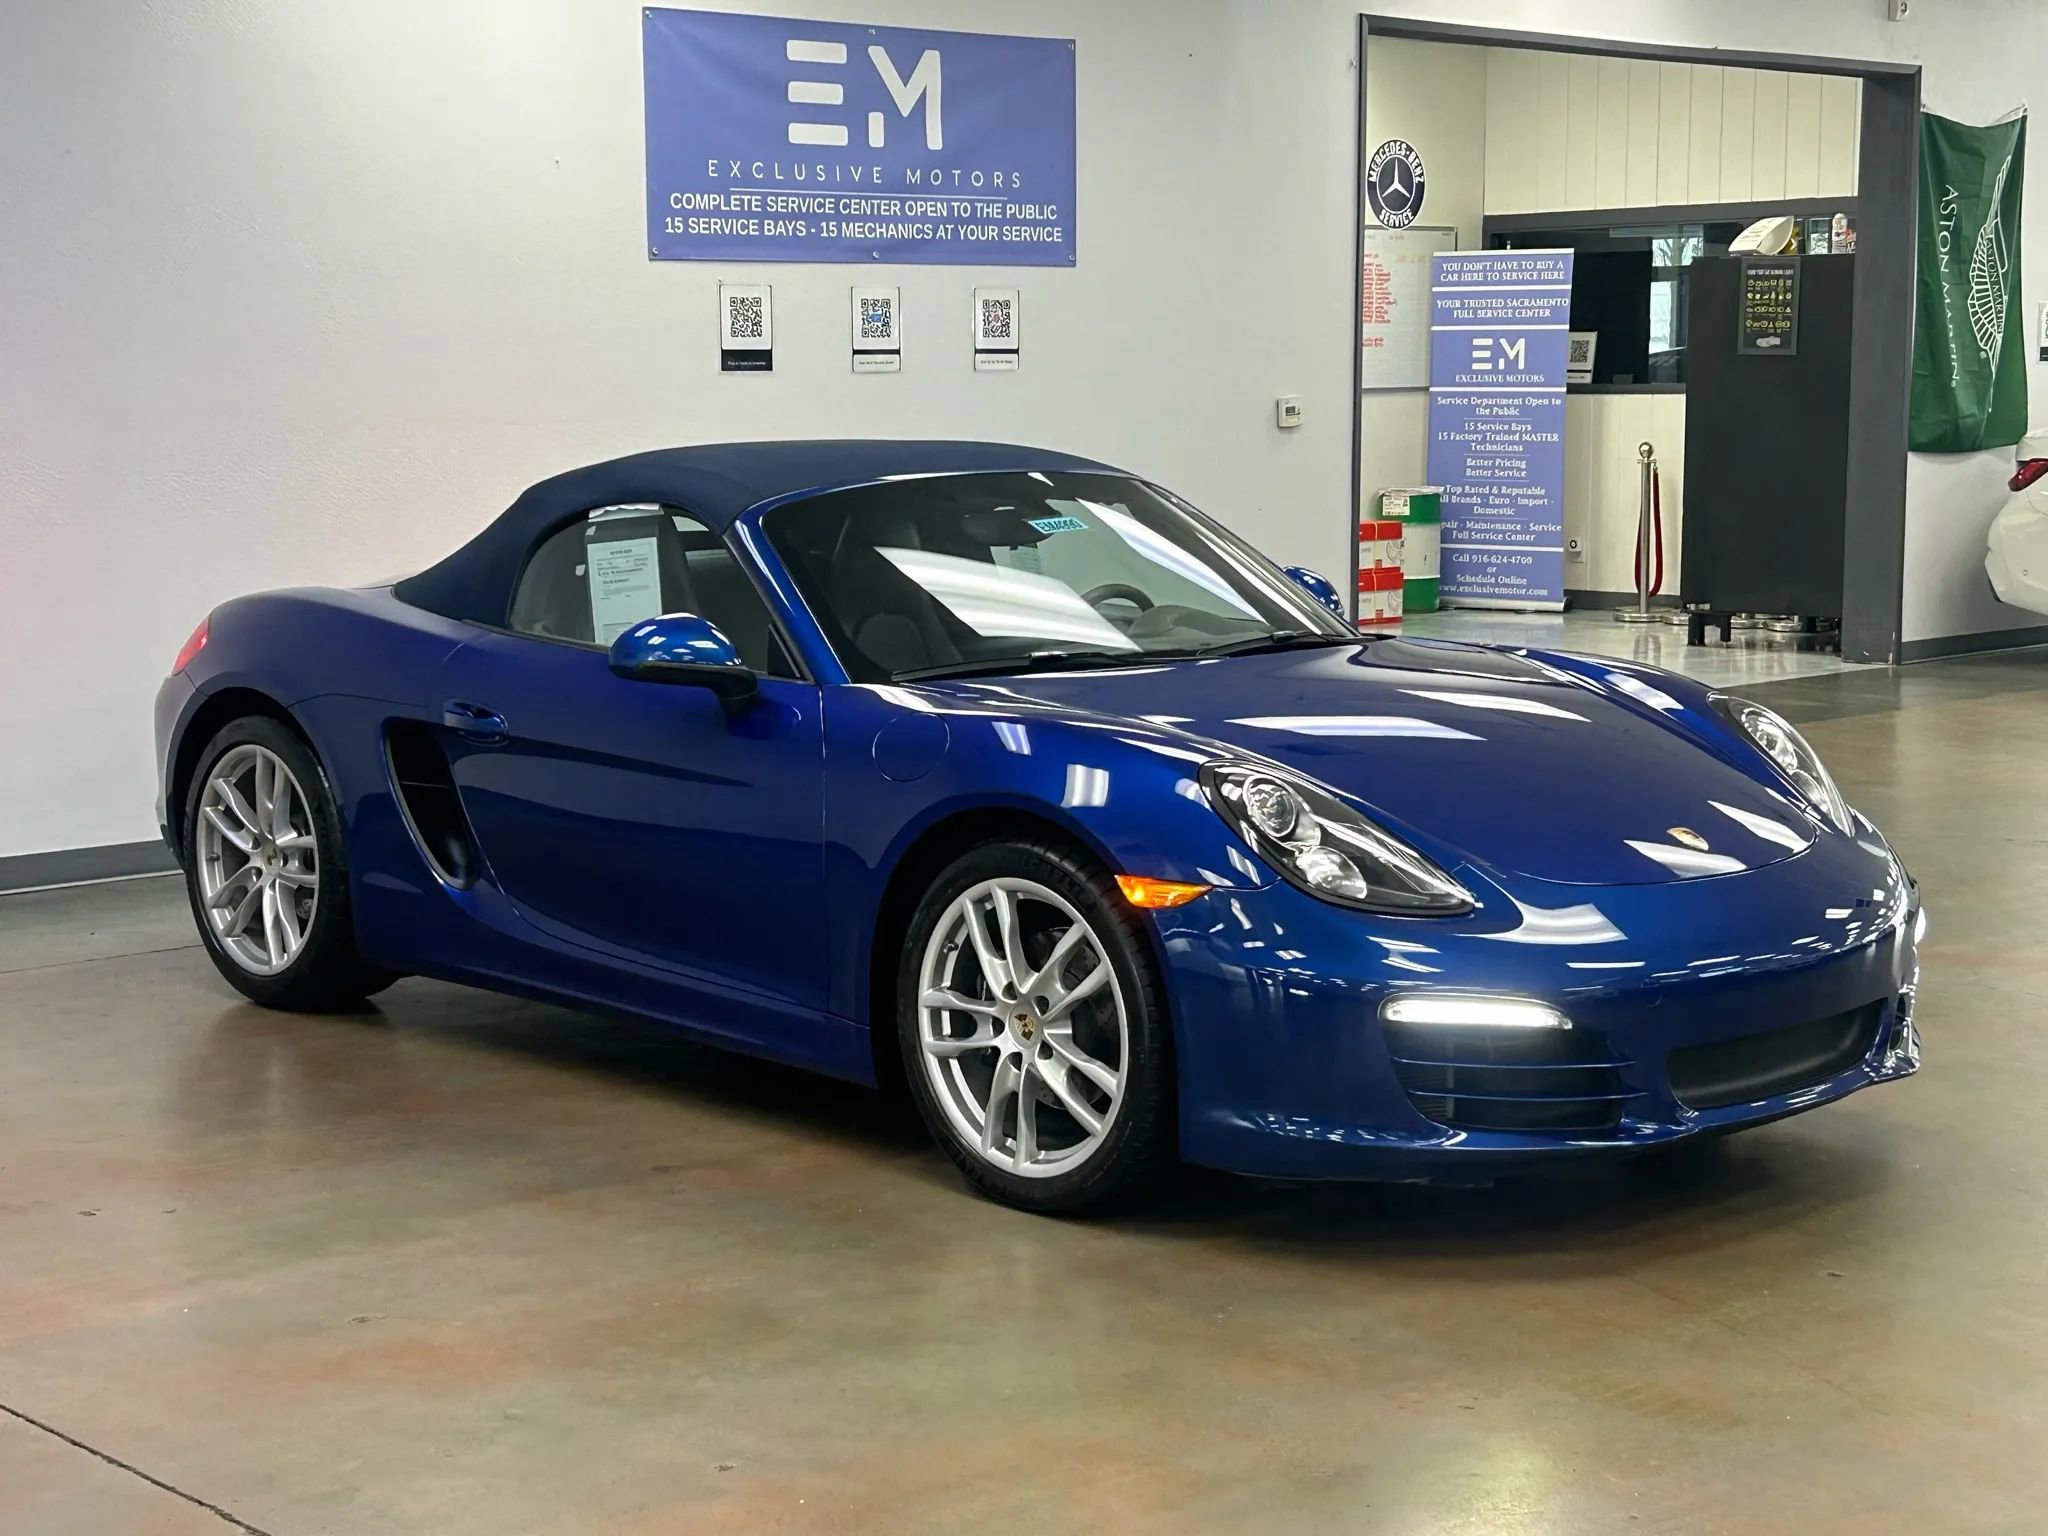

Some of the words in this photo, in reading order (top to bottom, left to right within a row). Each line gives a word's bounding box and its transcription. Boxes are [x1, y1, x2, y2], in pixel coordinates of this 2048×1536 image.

[787, 40, 943, 150] EM
[708, 160, 882, 183] EXCLUSIVE
[906, 168, 1020, 188] MOTORS
[670, 193, 762, 212] COMPLETE
[766, 196, 835, 214] SERVICE
[839, 198, 901, 216] CENTER
[905, 200, 947, 217] OPEN
[951, 202, 971, 218] TO
[975, 203, 1002, 219] THE
[1006, 204, 1057, 220] PUBLIC
[1379, 208, 1414, 228] SERVICE
[665, 217, 683, 234] 15
[688, 217, 760, 236] SERVICE
[764, 220, 807, 237] BAYS
[820, 221, 837, 238] 15
[841, 222, 933, 240] MECHANICS
[936, 224, 954, 240] AT
[958, 225, 999, 241] YOUR
[1002, 226, 1063, 242] SERVICE
[1939, 184, 1958, 272] ASTON
[1442, 263, 1461, 271] YOU
[1463, 262, 1492, 271] DON'T
[1494, 261, 1519, 270] HAVE
[1521, 261, 1534, 269] TO
[1536, 261, 1555, 269] BUY
[1557, 260, 1564, 268] A
[1986, 240, 1999, 281] ASTON
[1440, 273, 1459, 281] CAR
[1461, 273, 1484, 281] HERE
[1487, 272, 1500, 281] TO
[1502, 272, 1538, 280] SERVICE
[1541, 271, 1565, 280] HERE
[1437, 300, 1461, 308] YOUR
[1464, 299, 1504, 308] TRUSTED
[1507, 298, 1569, 307] SACRAMENTO
[1453, 310, 1474, 318] FULL
[1477, 309, 1513, 318] SERVICE
[1515, 308, 1551, 317] CENTER
[1472, 338, 1525, 370] EM
[1456, 374, 1504, 383] EXCLUSIVE
[1506, 374, 1545, 383] MOTORS
[1437, 397, 1468, 405] Service
[1471, 397, 1522, 407] Department
[1525, 397, 1549, 407] Open
[1552, 397, 1561, 405] to
[1476, 407, 1490, 415] the
[1492, 407, 1520, 416] Public
[1465, 422, 1475, 430] 15
[1477, 422, 1509, 431] Service
[1511, 422, 1532, 432] Bays
[1438, 432, 1448, 440] 15
[1450, 432, 1482, 442] Factory
[1486, 432, 1519, 441] Trained
[1522, 433, 1560, 442] MASTER
[1470, 443, 1523, 452] Technicians
[1466, 458, 1492, 466] Better
[1495, 458, 1526, 469] Pricing
[1465, 468, 1492, 477] Better
[1494, 468, 1527, 477] Service
[1445, 485, 1462, 494] Top
[1465, 485, 1489, 494] Rated
[1492, 485, 1499, 494] &
[1501, 486, 1546, 496] Reputable
[1451, 495, 1481, 504] Brands
[1489, 496, 1510, 505] Euro
[1517, 496, 1548, 507] Import
[1473, 506, 1515, 515] Domestic
[1440, 520, 1459, 530] pair
[1466, 521, 1521, 530] Maintenance
[1529, 522, 1562, 532] Service
[1452, 530, 1469, 539] Full
[1471, 531, 1503, 540] Service
[1505, 532, 1536, 541] Center
[1452, 553, 1469, 562] Call
[1456, 574, 1495, 583] Schedule
[1498, 576, 1527, 585] Online
